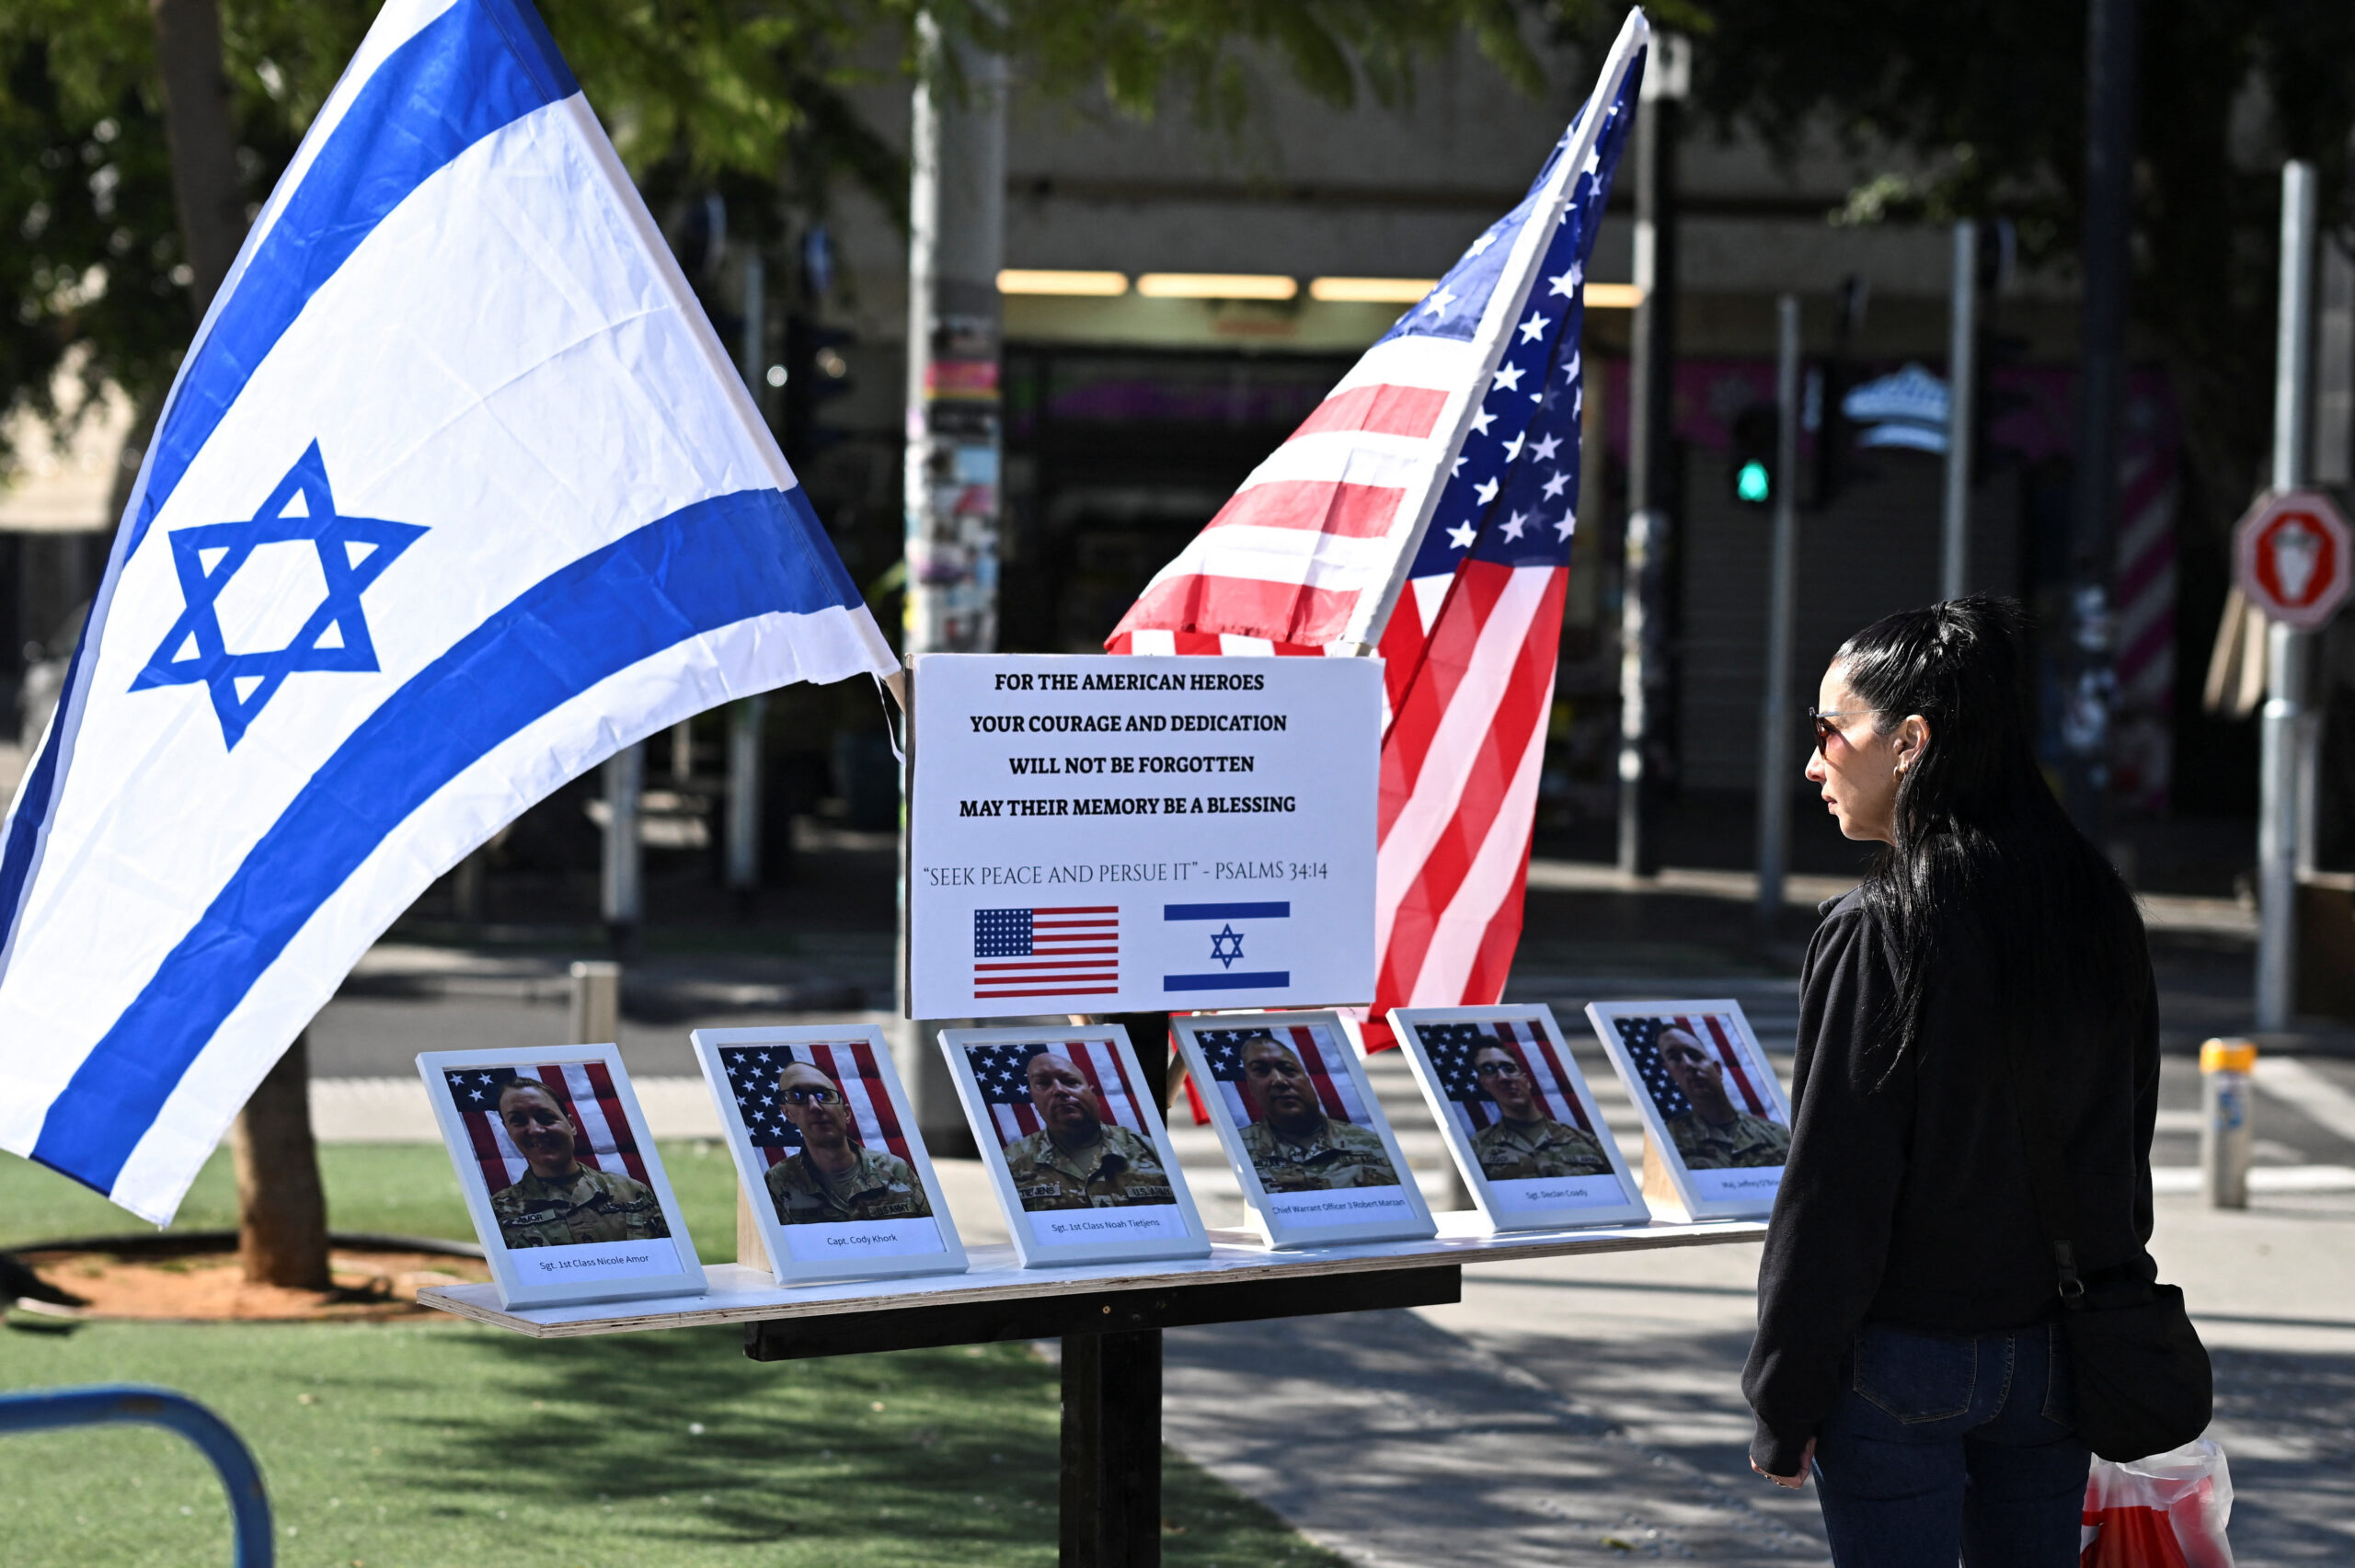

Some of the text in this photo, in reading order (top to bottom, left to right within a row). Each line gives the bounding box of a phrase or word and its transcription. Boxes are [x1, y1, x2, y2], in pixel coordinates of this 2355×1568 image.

[994, 674, 1265, 691] FOR THE AMERICAN HEROES
[970, 715, 1287, 732] YOUR COURAGE AND DEDICATION
[1009, 756, 1255, 774] WILL NOT BE FORGOTTEN
[959, 795, 1296, 818] MAY THEIR MEMORY BE A BLESSING
[923, 866, 975, 886] “SEEK
[981, 865, 1043, 886] PEACE
[1048, 864, 1094, 884] AND
[1098, 863, 1168, 883] PERSUE
[1173, 861, 1199, 881] IT”
[1215, 861, 1284, 880] PSALMS
[1289, 862, 1328, 883] 34:14
[1271, 1206, 1292, 1215] Chief
[1292, 1204, 1322, 1213] Warrant
[1051, 1224, 1069, 1233] Sgt.
[1083, 1221, 1104, 1230] Class
[1105, 1220, 1127, 1229] Noah
[1128, 1219, 1161, 1228] Tietjens
[827, 1233, 898, 1247] Capt. Cody Khork
[539, 1254, 649, 1272] Sgt. 1st Class Nicole Amor
